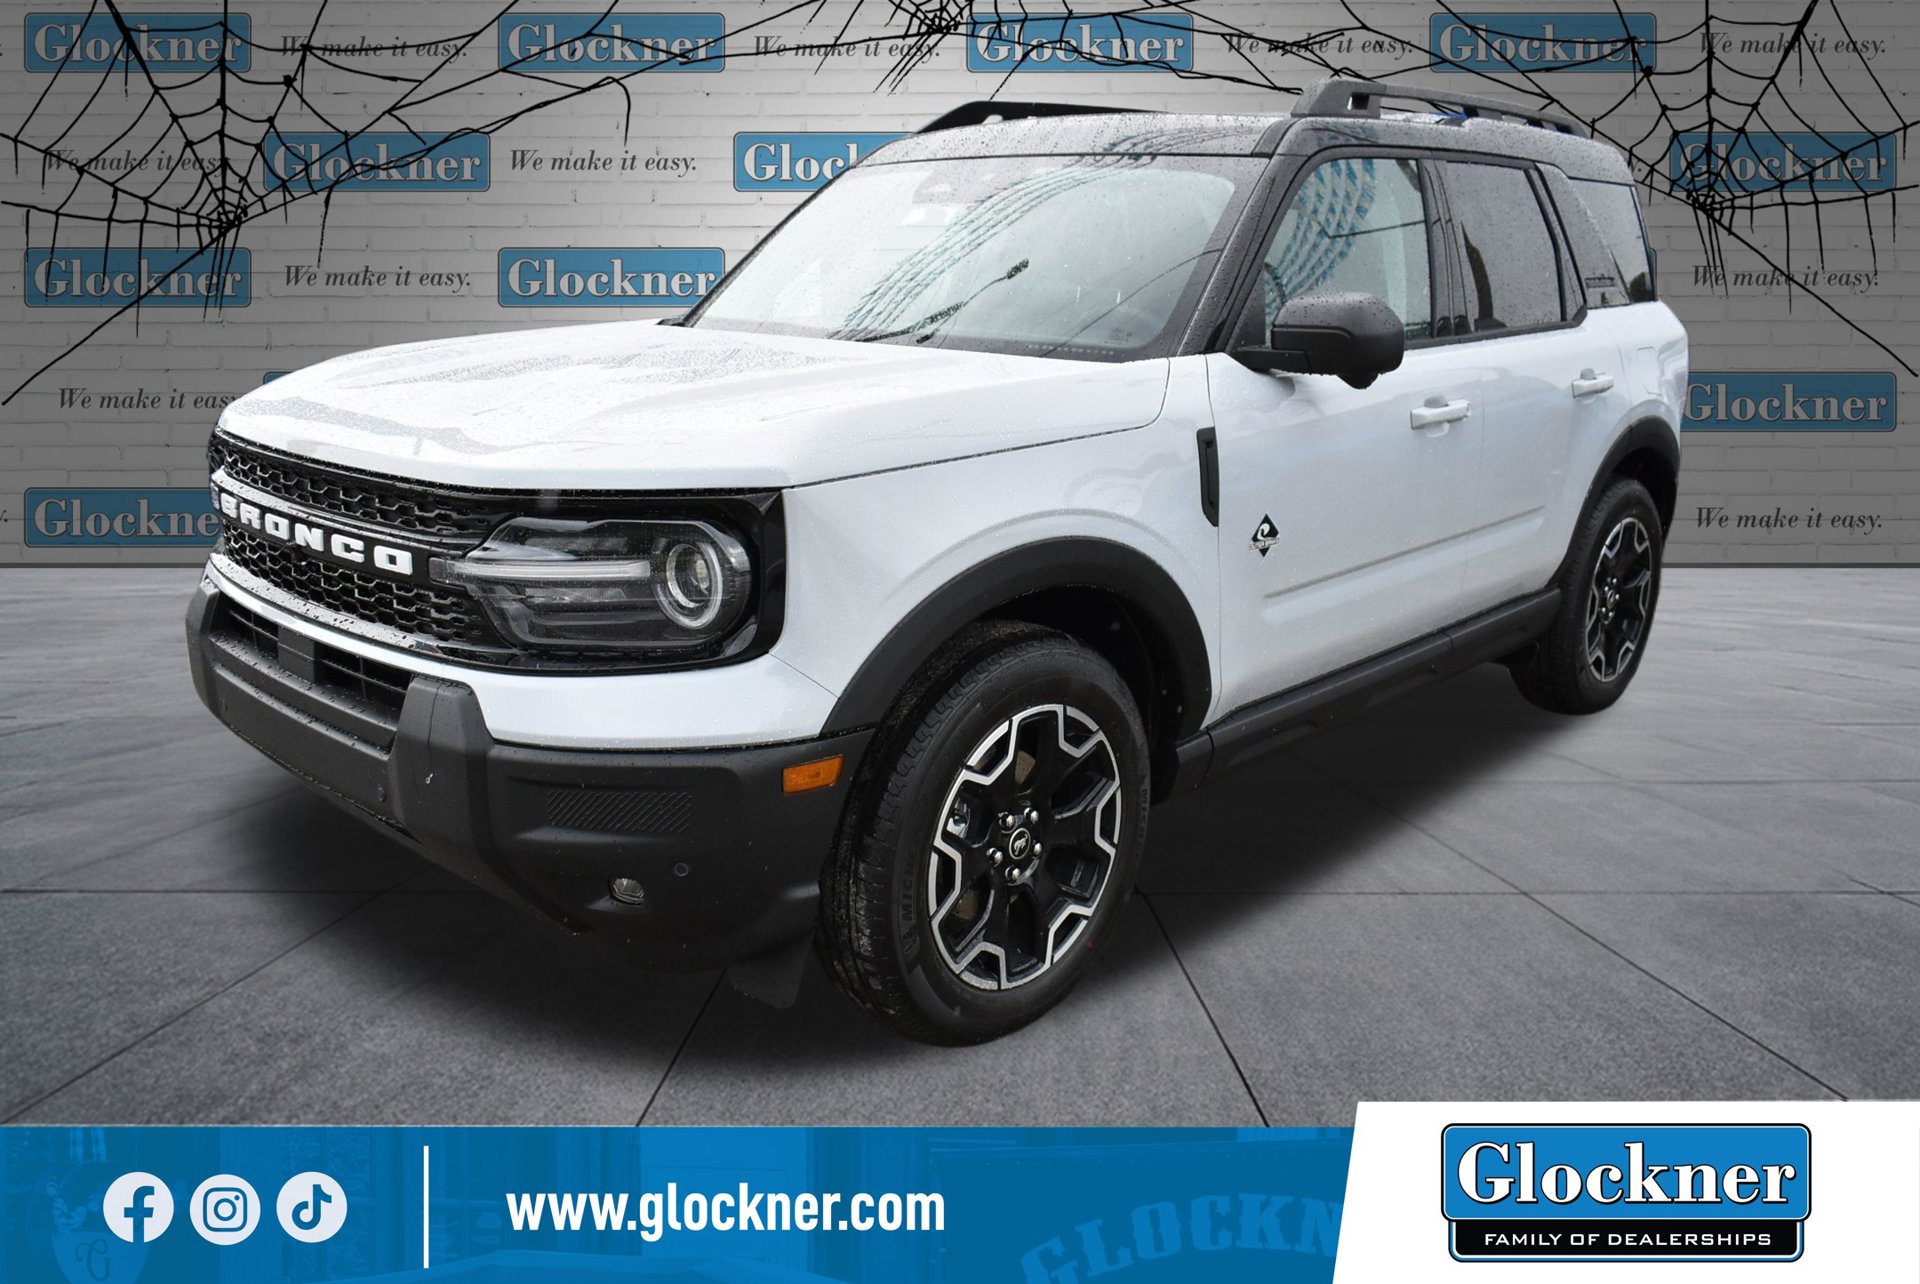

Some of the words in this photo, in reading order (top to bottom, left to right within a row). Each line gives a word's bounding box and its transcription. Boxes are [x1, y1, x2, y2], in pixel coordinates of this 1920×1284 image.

[34, 24, 241, 62] Glockner
[322, 36, 383, 56] make
[391, 36, 408, 56] it
[416, 42, 467, 64] easy.
[508, 24, 715, 62] Glockner
[754, 36, 787, 56] We
[795, 36, 856, 56] make
[864, 36, 881, 56] it
[976, 24, 1183, 62] Glockner
[1226, 32, 1259, 54] We
[1336, 33, 1353, 54] it
[1361, 40, 1412, 60] easy.
[1439, 24, 1647, 62] Glockner
[1700, 32, 1732, 54] We
[1810, 33, 1826, 54] it
[1834, 40, 1886, 60] easy.
[48, 150, 80, 170] We
[88, 150, 150, 170] make
[158, 150, 174, 170] it
[273, 143, 481, 182] Glockner
[510, 150, 543, 170] We
[551, 150, 612, 170] make
[620, 150, 637, 170] it
[645, 156, 696, 178] easy.
[1679, 143, 1887, 182] Glockner
[34, 258, 241, 297] Glockner
[285, 266, 318, 286] We
[326, 266, 387, 286] make
[395, 266, 412, 286] it
[420, 272, 471, 294] easy.
[508, 258, 715, 297] Glockner
[1692, 266, 1725, 286] We
[1733, 266, 1794, 286] make
[1802, 266, 1819, 286] it
[1827, 272, 1878, 294] easy.
[58, 388, 91, 408] We
[99, 388, 160, 408] make
[168, 388, 185, 408] it
[1683, 383, 1887, 422] Glockner
[220, 492, 413, 576] BRONCO
[1696, 507, 1729, 528] We
[1737, 507, 1798, 528] make
[1806, 508, 1823, 528] it
[1831, 514, 1882, 535] easy.
